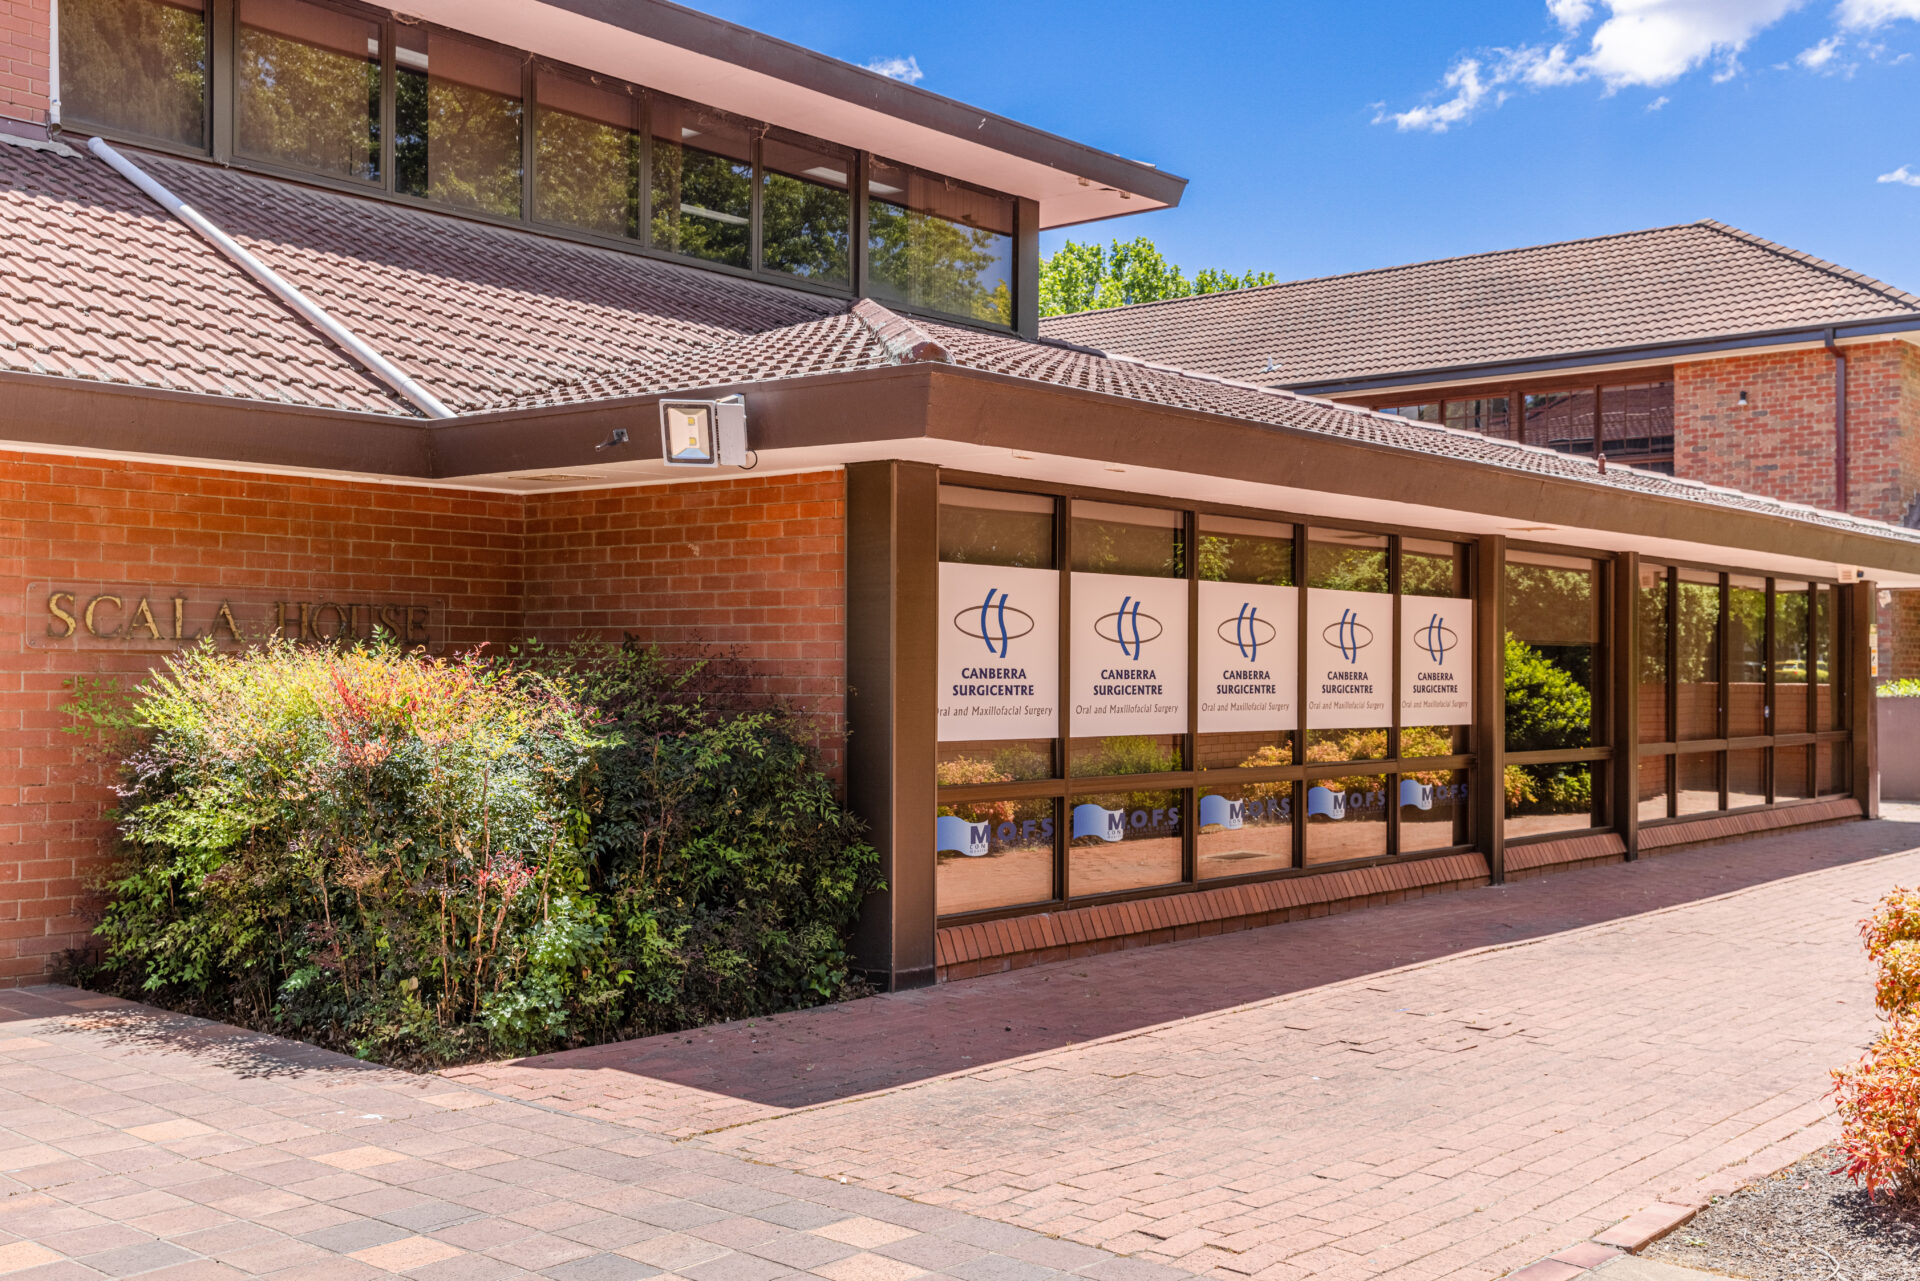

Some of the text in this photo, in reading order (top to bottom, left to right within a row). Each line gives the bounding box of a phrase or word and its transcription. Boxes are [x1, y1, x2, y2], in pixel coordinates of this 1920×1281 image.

[47, 590, 430, 645] SCALA HOUSE
[960, 668, 1027, 679] CANBERRA
[1100, 669, 1156, 680] CANBERRA
[1223, 670, 1271, 680] CANBERRA
[1327, 671, 1369, 681] CANBERRA
[1418, 672, 1455, 681] CANBERRA
[952, 684, 1035, 696] SURGICENTRE
[1093, 684, 1163, 696] SURGICENTRE
[1216, 684, 1277, 695] SURGICENTRE
[1321, 684, 1374, 694] SURGICENTRE
[1413, 684, 1459, 694] SURGICENTRE
[953, 706, 968, 716] and
[971, 705, 1022, 716] Maxillofacial
[1024, 705, 1053, 717] Surgery
[1075, 704, 1179, 716] Oral and Maxillofacial Surgery
[1201, 702, 1290, 712] Oral and Maxillofacial Surgery
